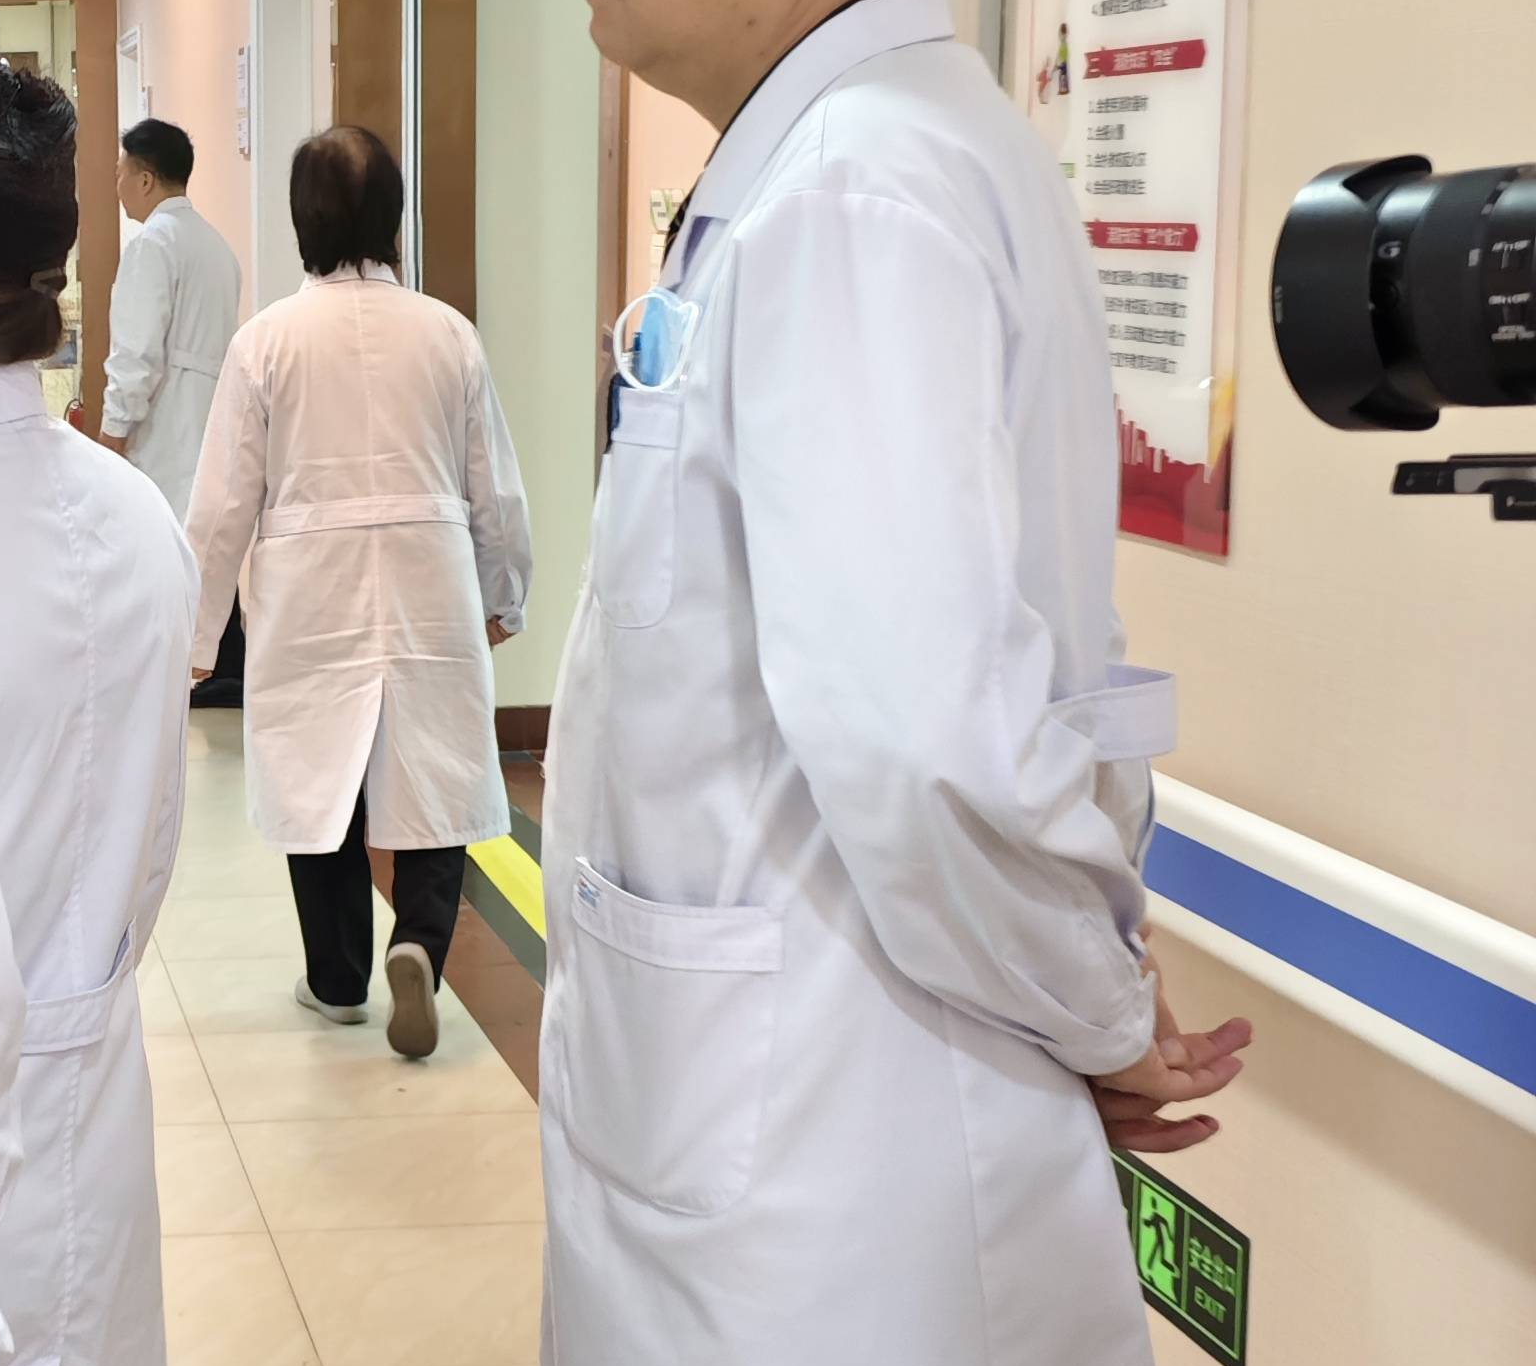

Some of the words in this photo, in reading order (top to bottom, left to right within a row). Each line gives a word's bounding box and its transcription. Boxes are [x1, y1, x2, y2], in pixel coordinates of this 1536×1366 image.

[1188, 1236, 1236, 1297] 安全出口
[1194, 1285, 1227, 1324] EXIT
